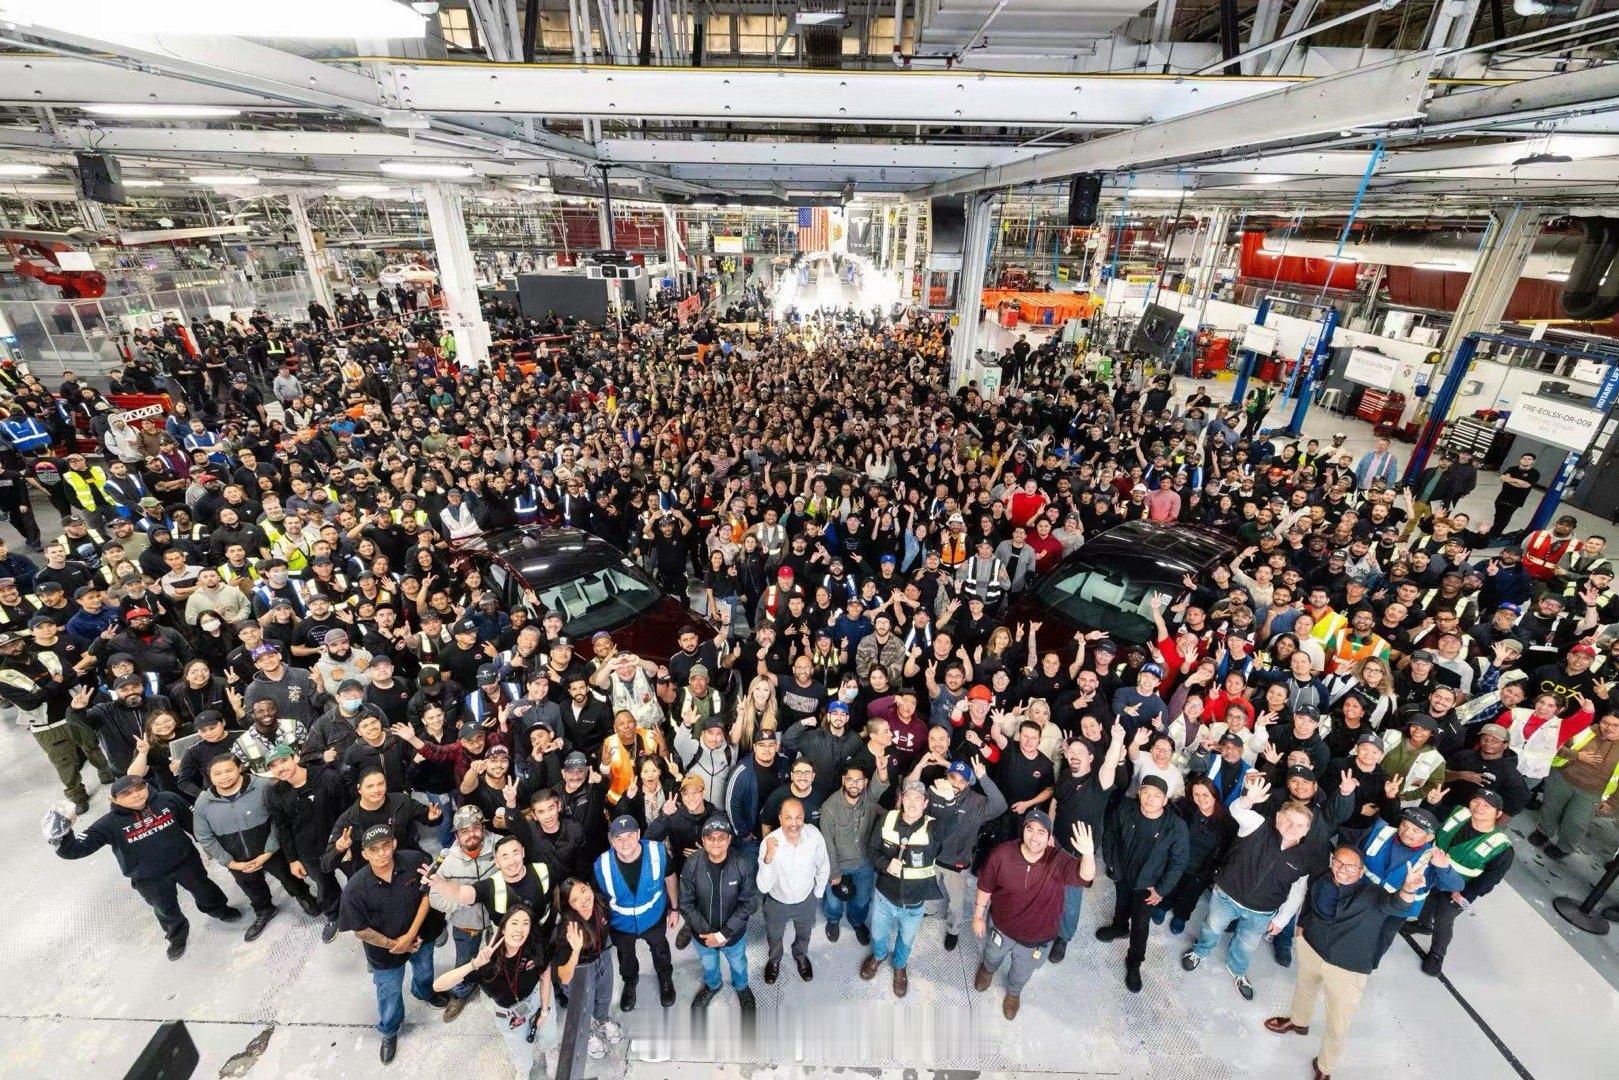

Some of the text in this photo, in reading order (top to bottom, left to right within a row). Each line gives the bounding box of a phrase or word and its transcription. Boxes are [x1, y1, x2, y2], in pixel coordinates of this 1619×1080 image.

[122, 807, 171, 833] TESLA
[127, 818, 174, 844] BASKETBALL
[365, 828, 389, 840] TOWN
